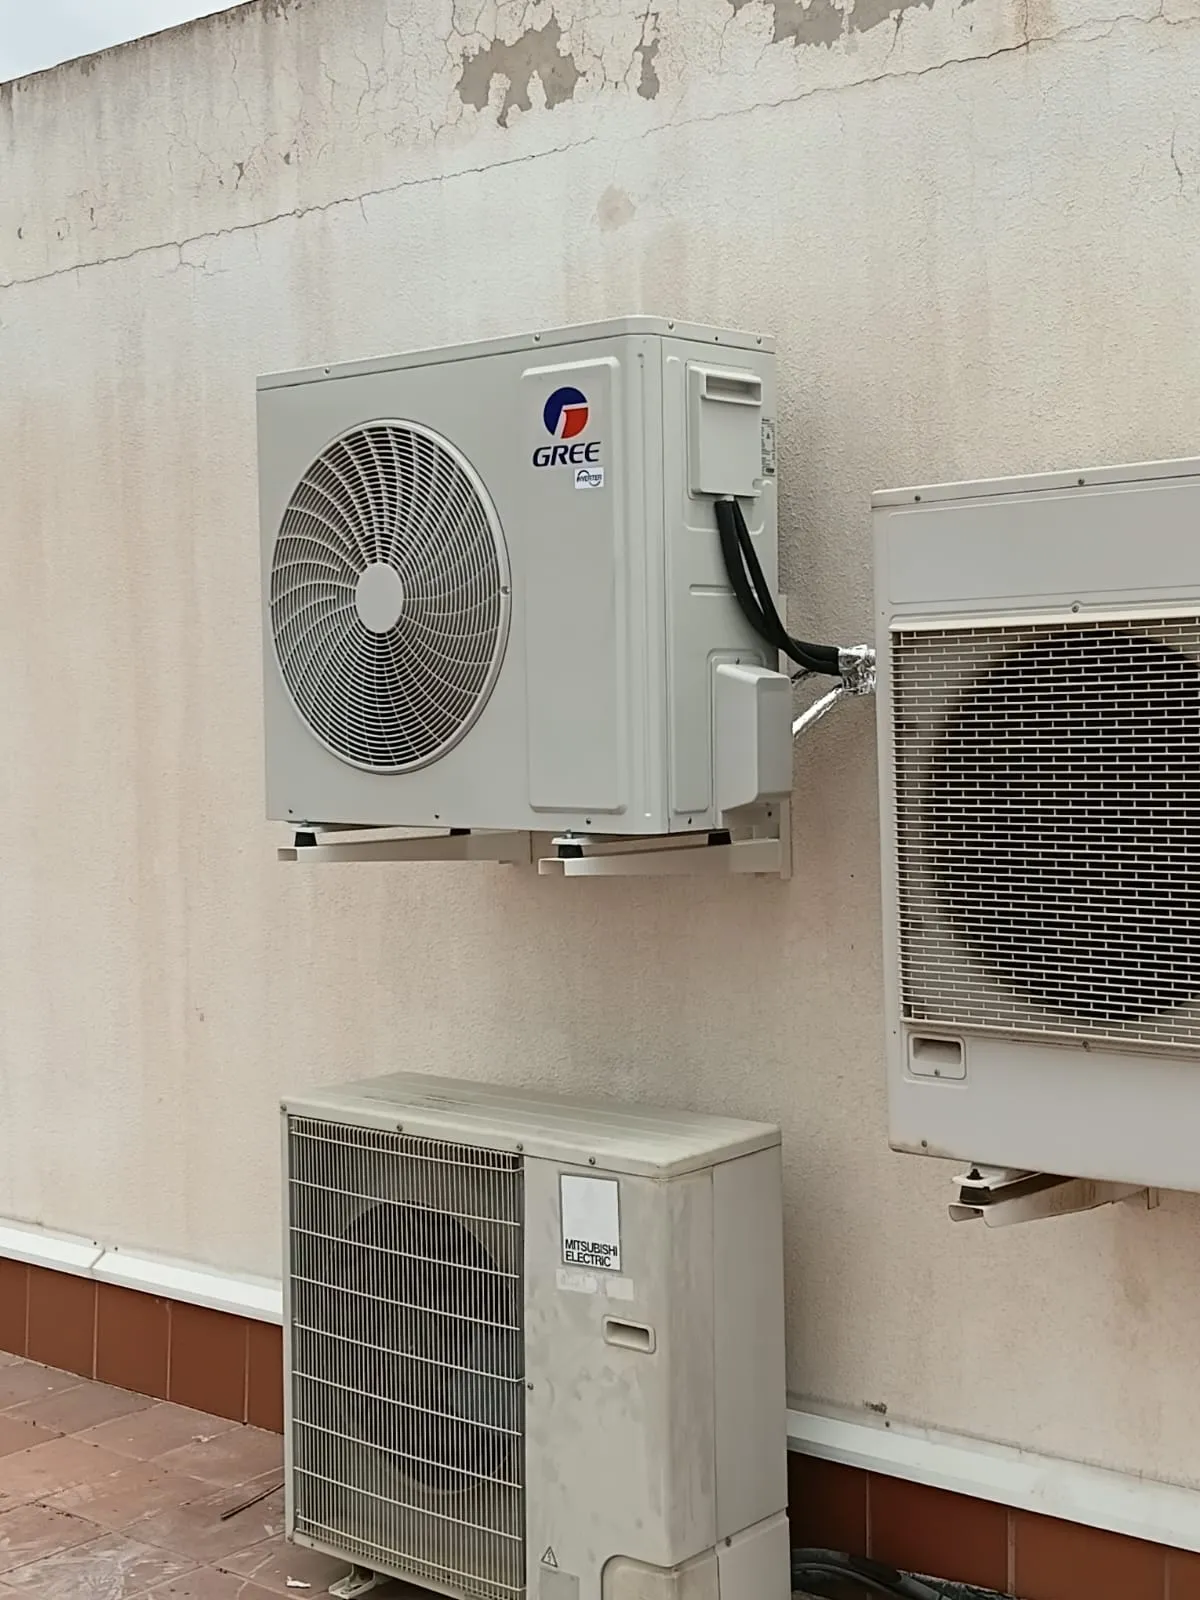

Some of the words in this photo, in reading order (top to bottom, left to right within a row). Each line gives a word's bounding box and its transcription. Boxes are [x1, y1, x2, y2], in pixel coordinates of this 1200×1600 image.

[532, 441, 602, 467] GREE
[565, 1239, 618, 1256] MITSUBISHI
[565, 1251, 611, 1267] ELECTRIC
